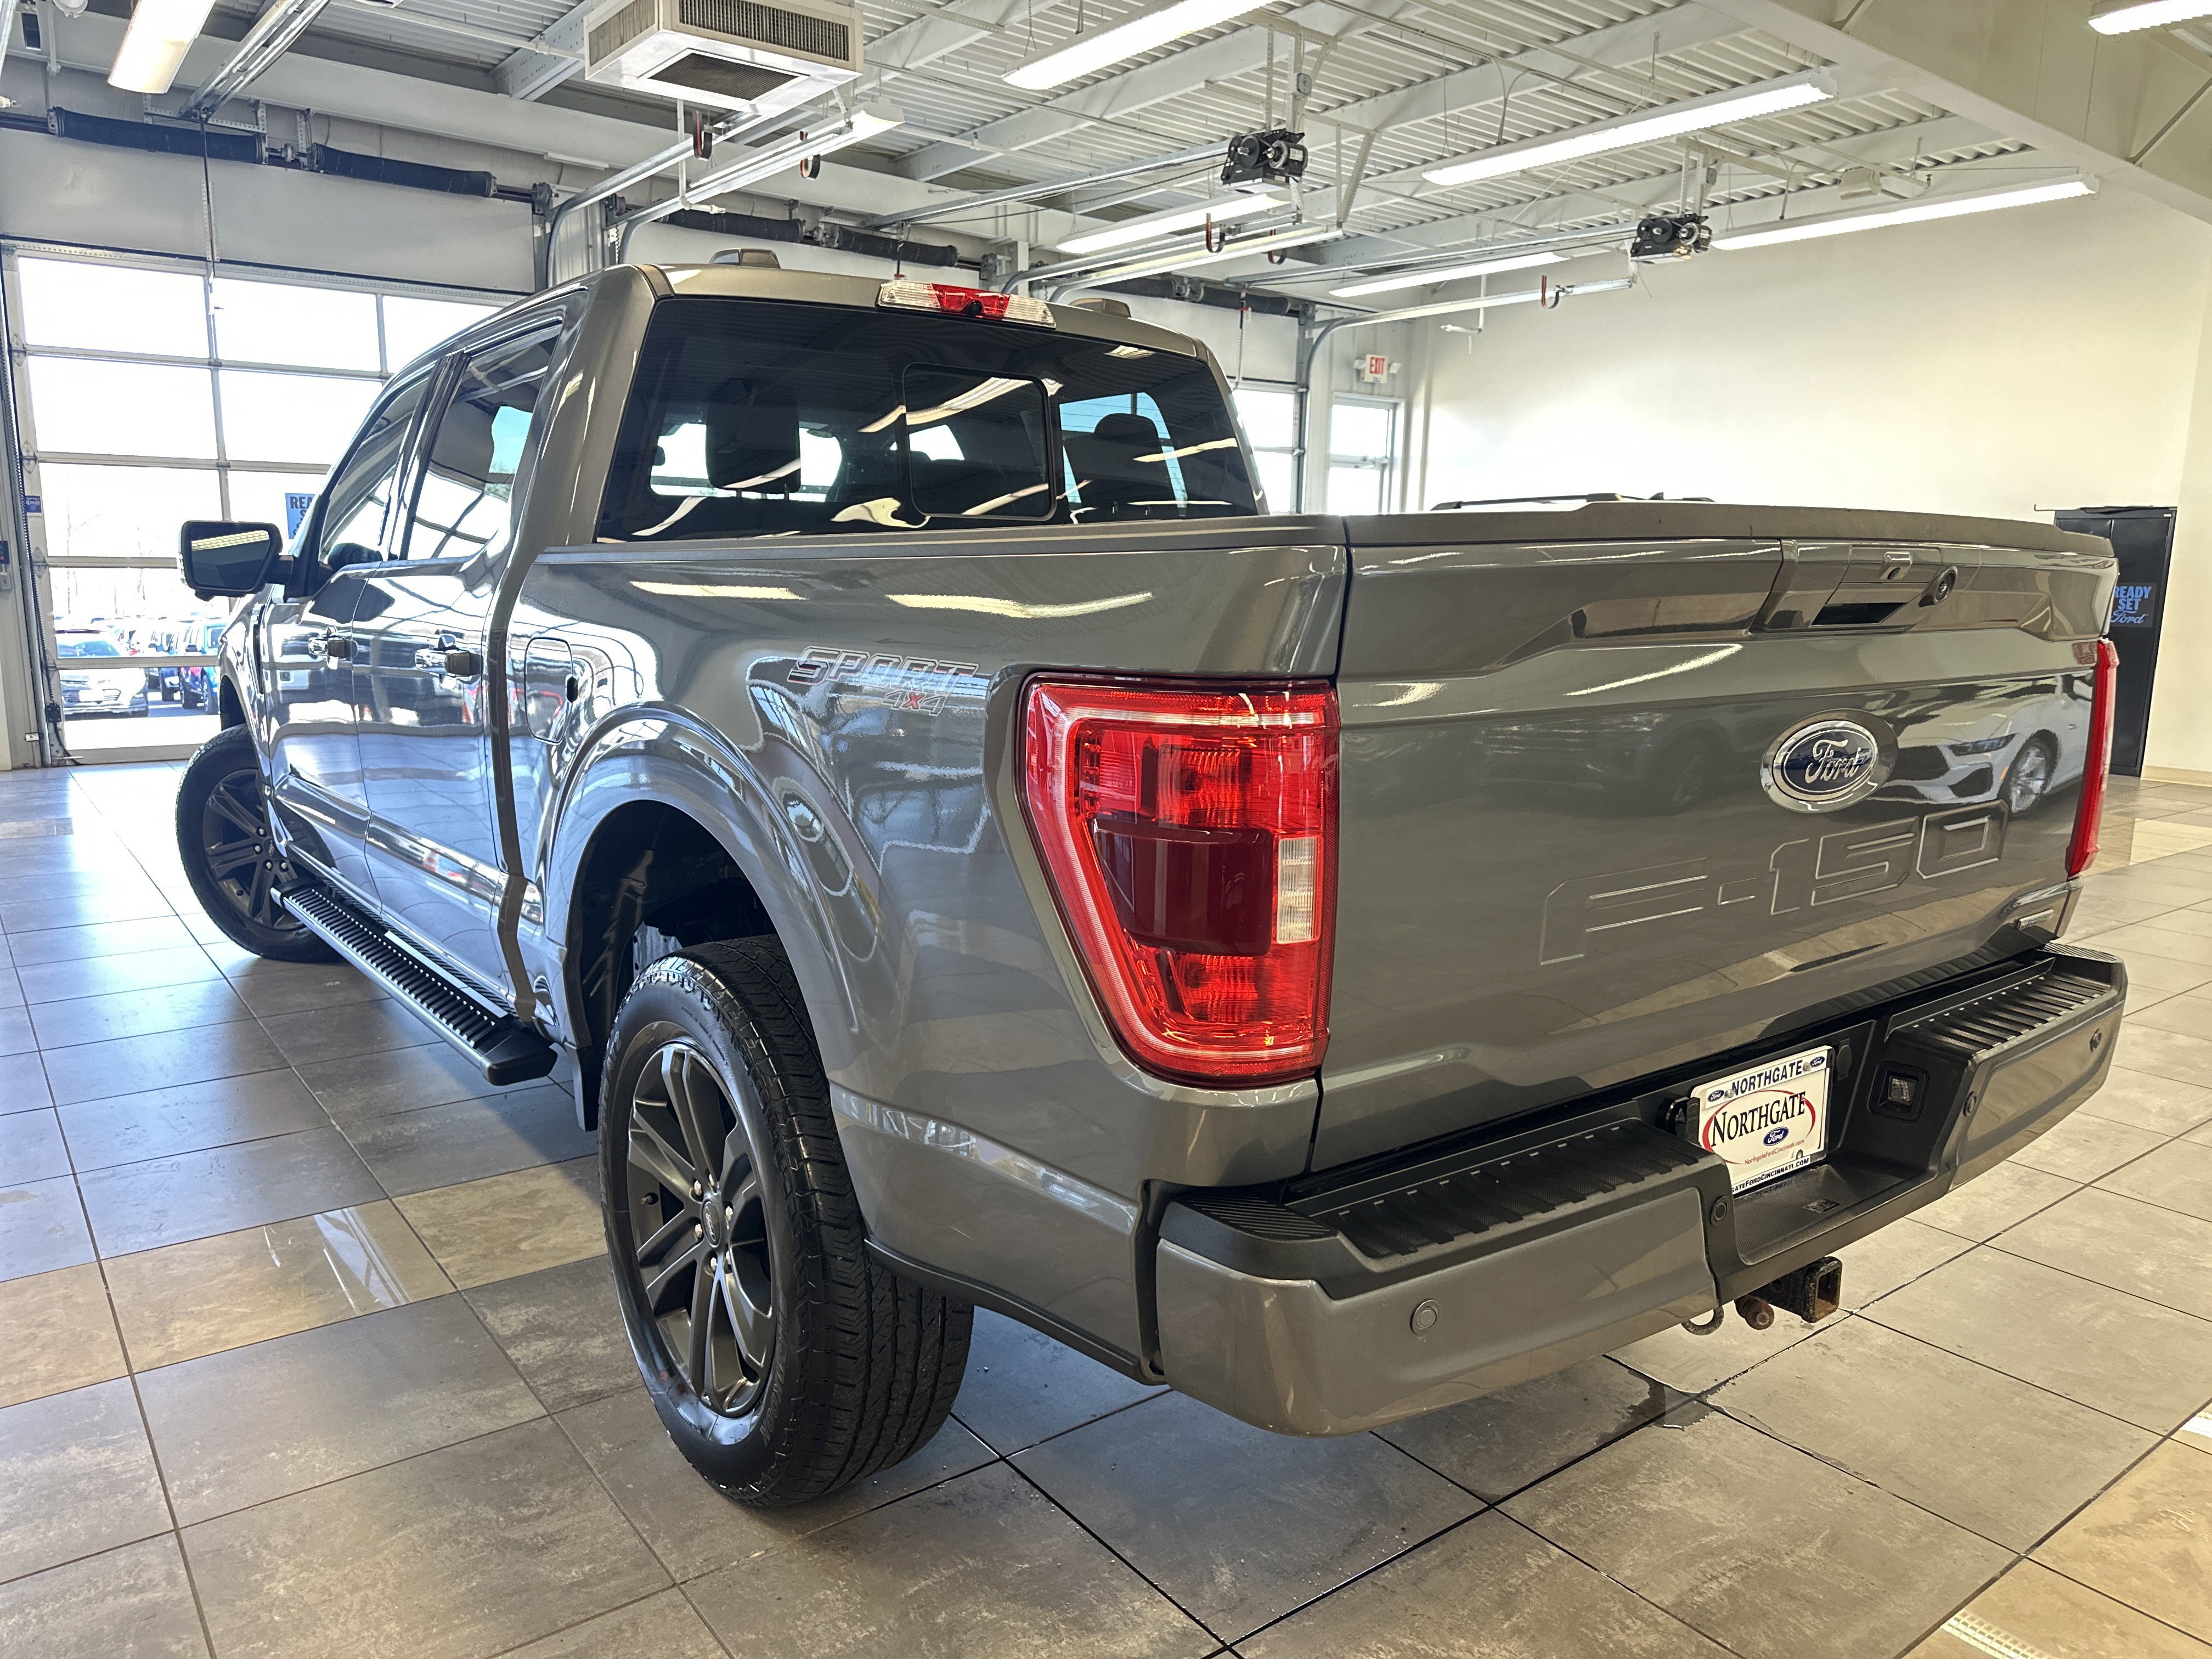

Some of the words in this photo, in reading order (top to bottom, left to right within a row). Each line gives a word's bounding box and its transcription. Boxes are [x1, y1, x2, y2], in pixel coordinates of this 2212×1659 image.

[1369, 357, 1386, 375] EXIT
[290, 496, 312, 509] REA
[2114, 585, 2152, 599] READY
[2118, 598, 2141, 610] SET
[2111, 610, 2148, 624] Ford
[787, 645, 980, 696] SPORT
[1805, 738, 1862, 785] Ford
[1538, 799, 2010, 966] F-150
[1731, 1059, 1803, 1096] NORTHGATE
[1744, 1139, 1804, 1165] NorthgateFordCincinnati.com
